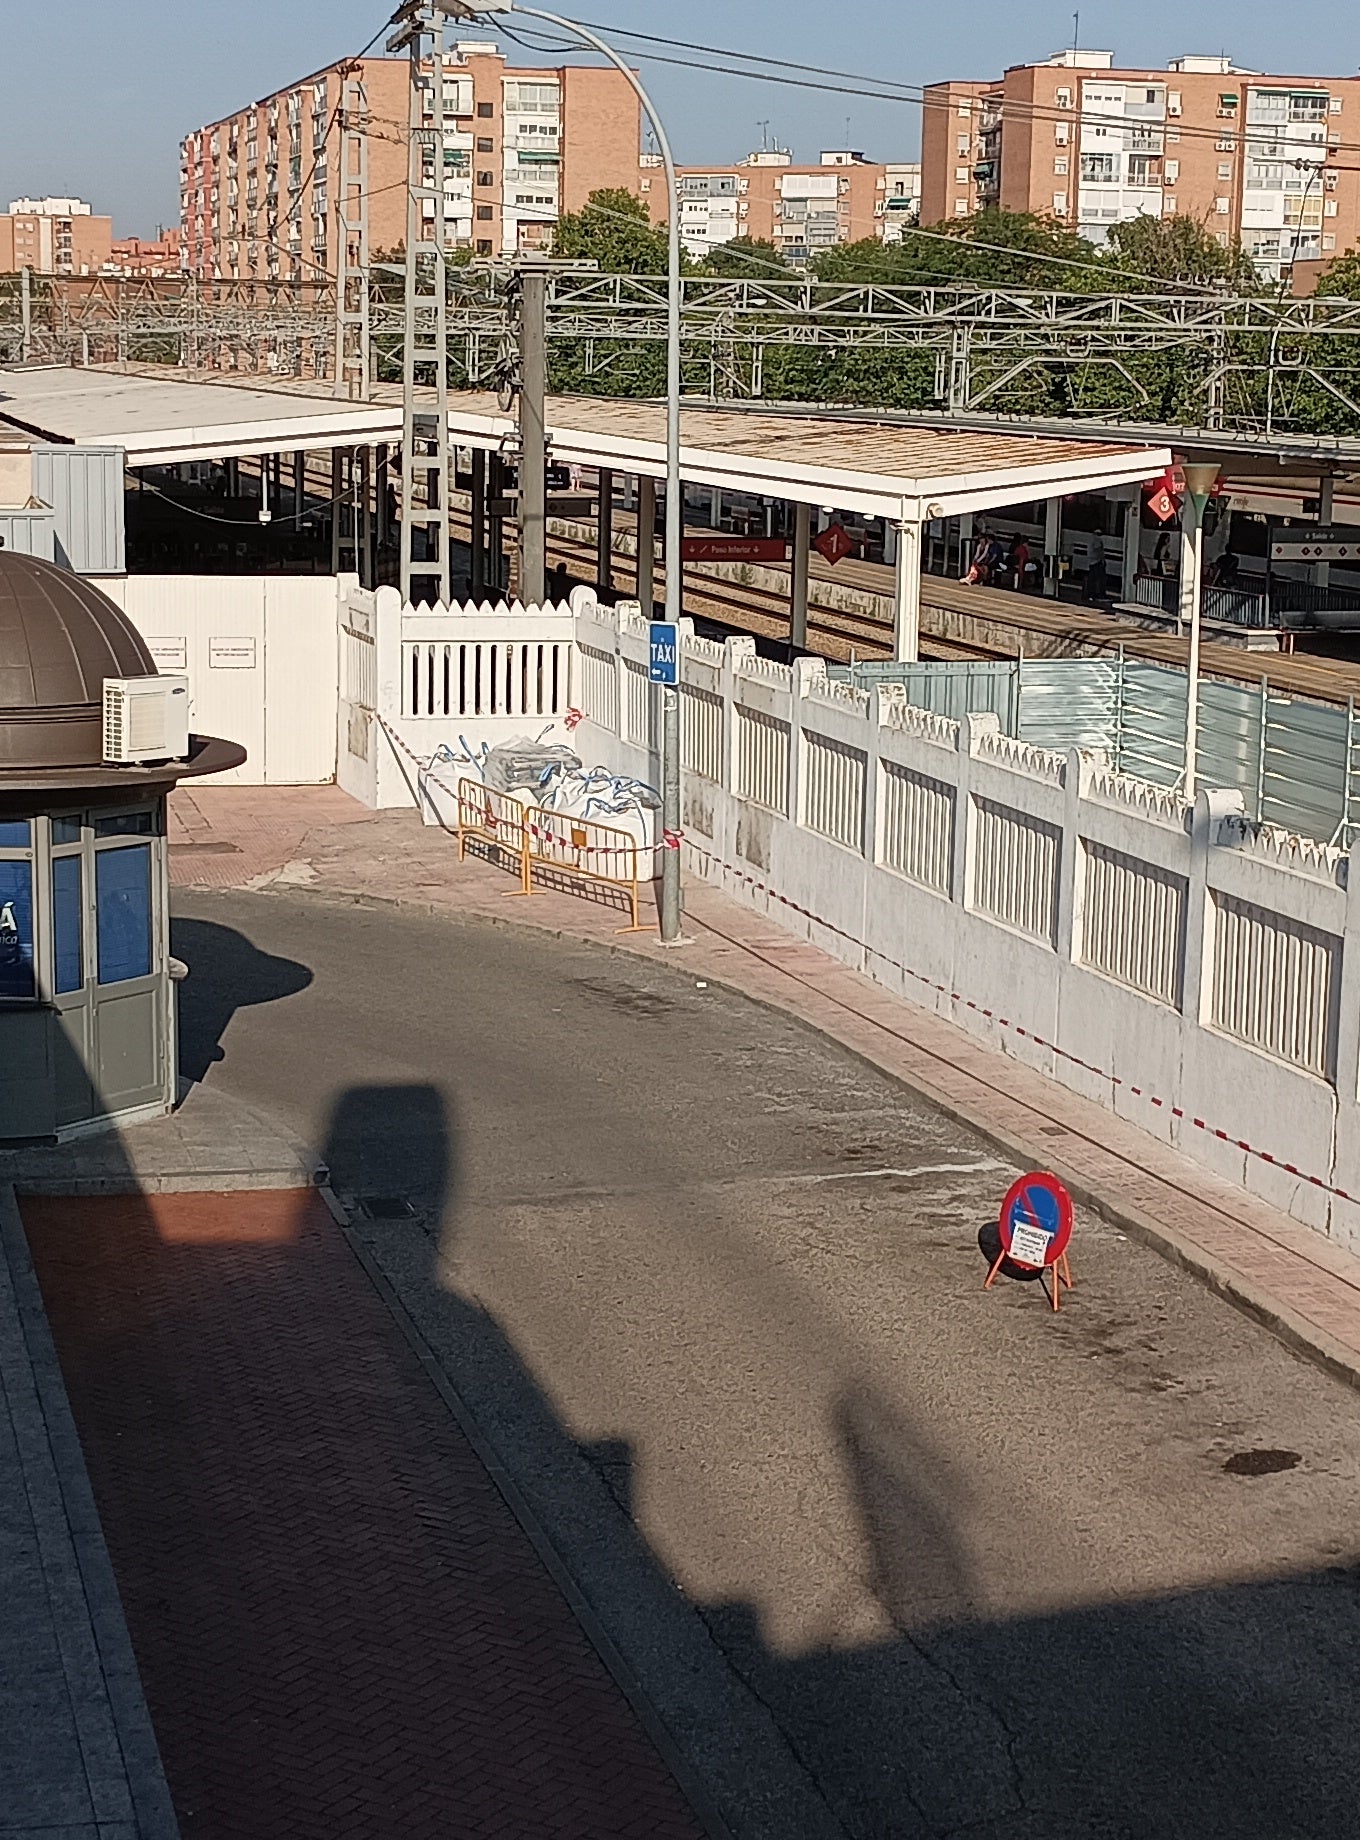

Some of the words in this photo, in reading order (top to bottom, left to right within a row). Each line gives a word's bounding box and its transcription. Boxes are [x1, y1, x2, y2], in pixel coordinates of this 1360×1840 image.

[1160, 495, 1170, 512] 3
[829, 533, 838, 554] 1
[650, 643, 675, 663] TAXI
